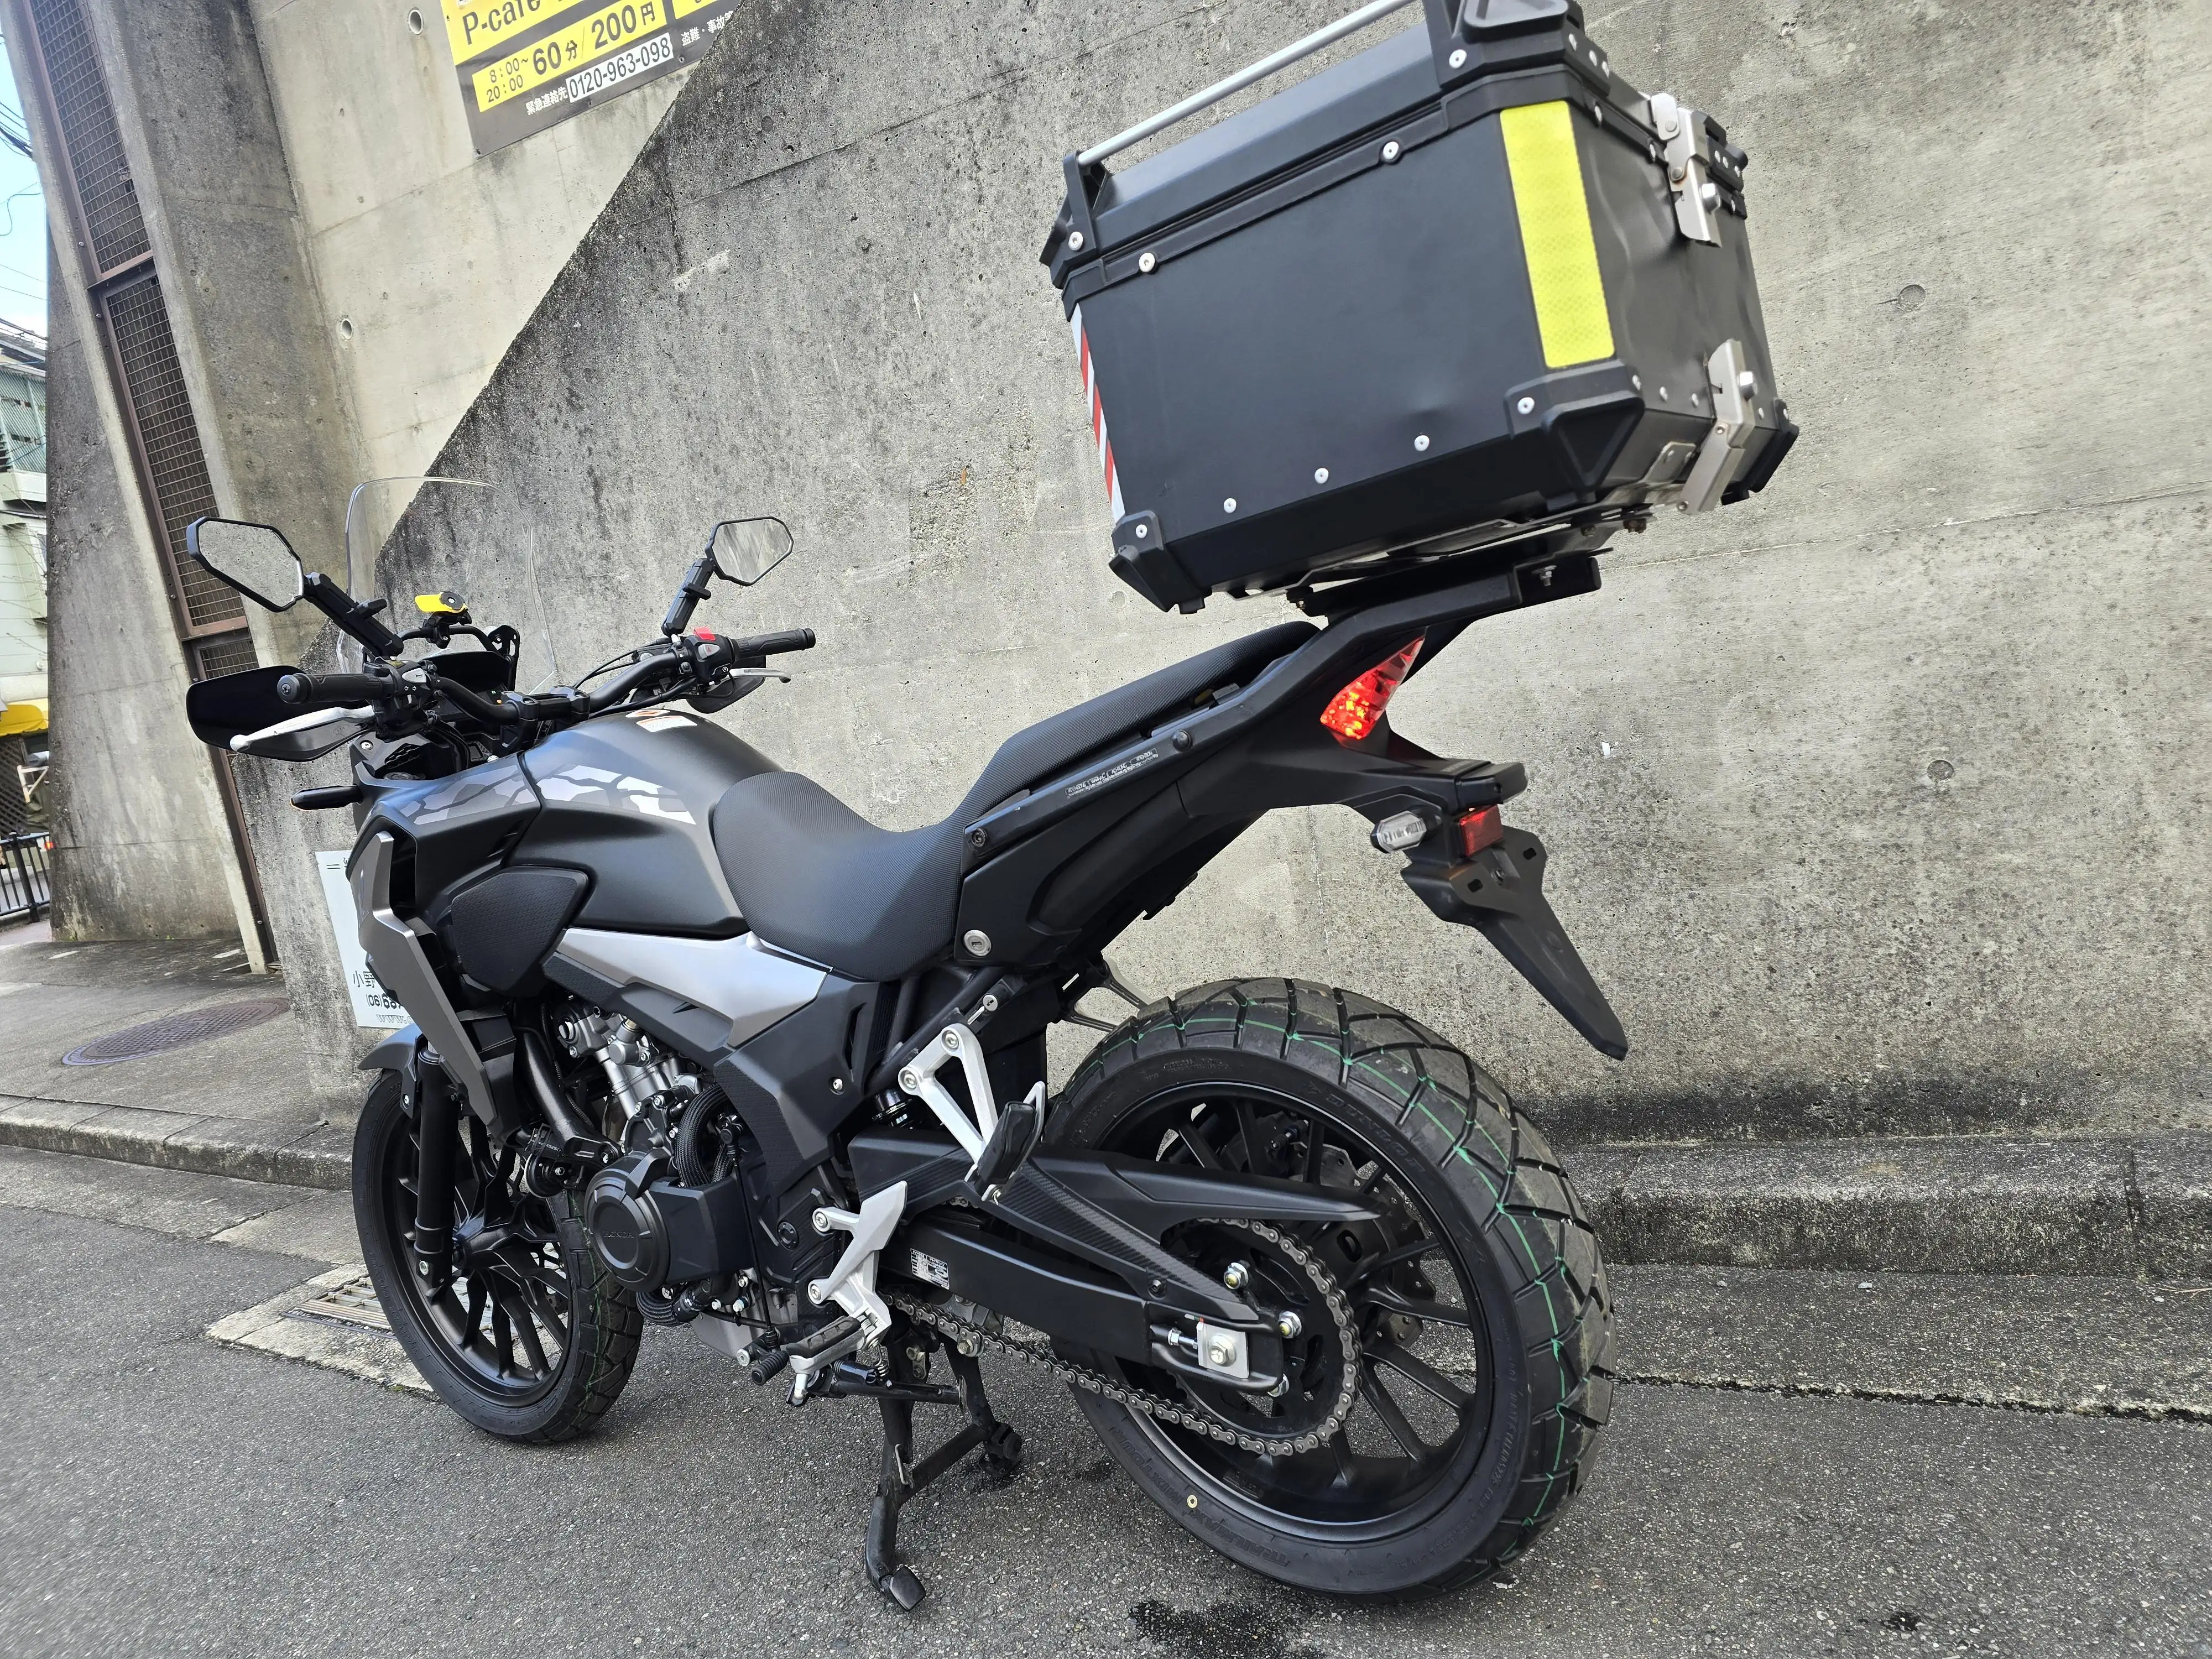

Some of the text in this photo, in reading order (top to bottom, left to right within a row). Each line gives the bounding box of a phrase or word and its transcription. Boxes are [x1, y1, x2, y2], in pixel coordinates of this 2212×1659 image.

[487, 75, 523, 103] 20:00
[526, 37, 670, 116] 緊急連絡先 0120-963-098
[366, 993, 401, 1009] (06)68
[1325, 1093, 1426, 1173] DUNLOP
[601, 1229, 635, 1239] HONDA
[1109, 1427, 1291, 1567] TRAILMAX MIXTOUR
